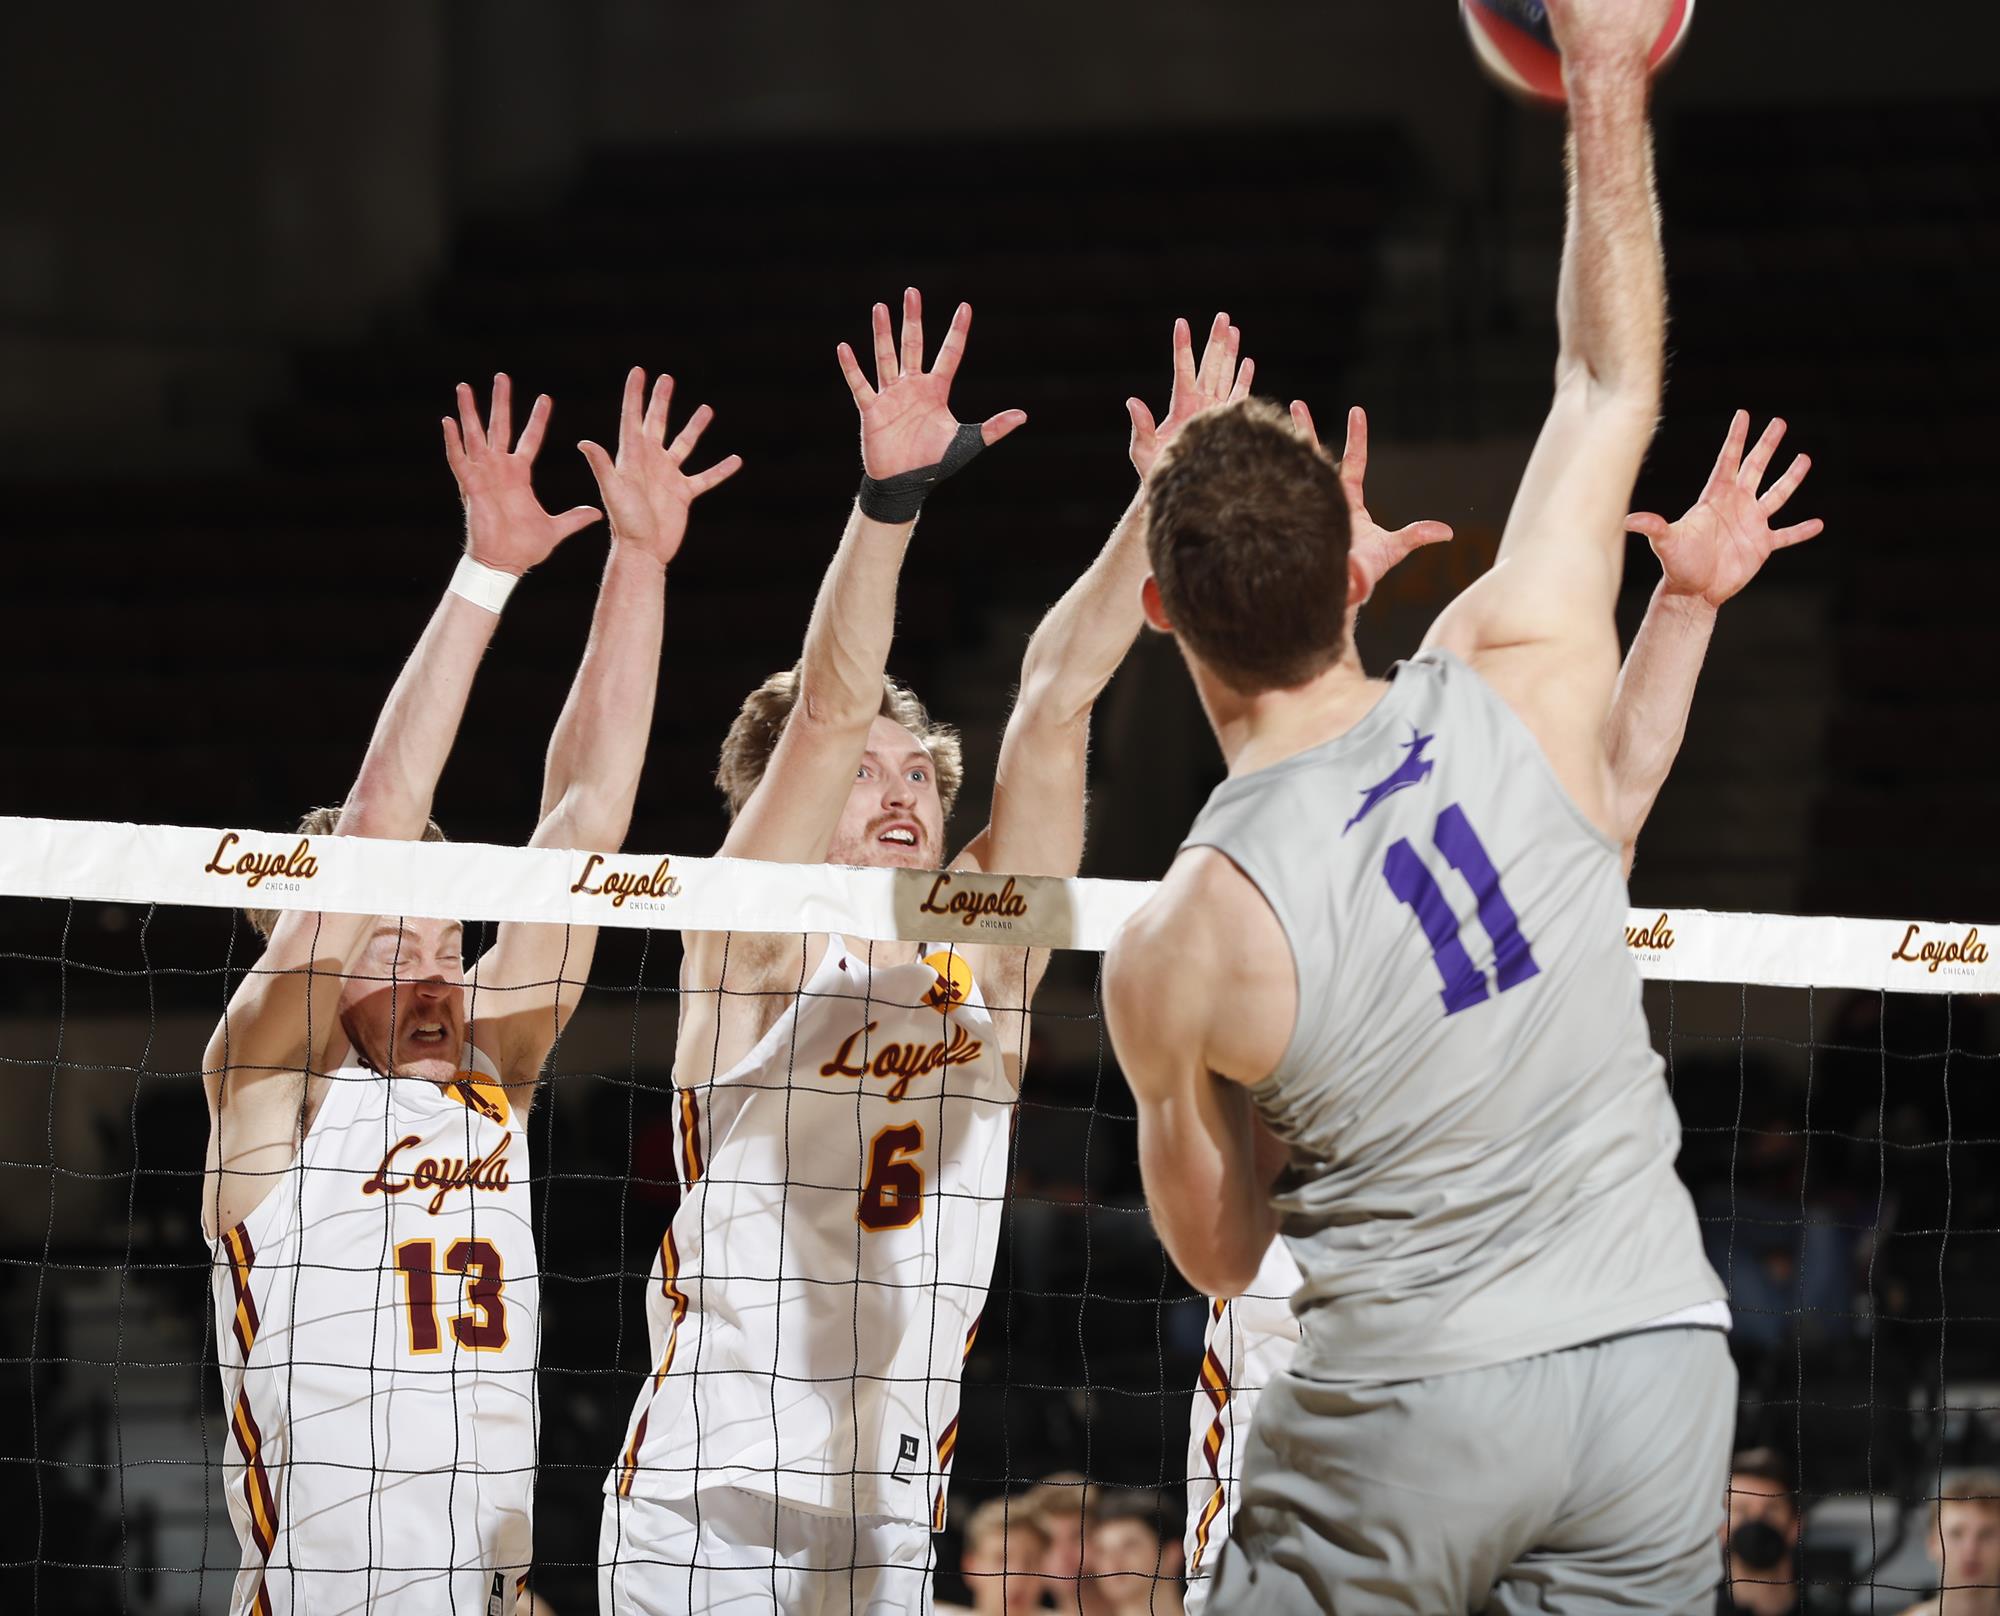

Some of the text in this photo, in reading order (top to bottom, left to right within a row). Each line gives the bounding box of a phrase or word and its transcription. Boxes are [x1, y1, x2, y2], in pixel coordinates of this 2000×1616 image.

[205, 832, 319, 888] Loyola
[570, 854, 682, 908] Loyola
[265, 882, 300, 892] CHICAGO
[629, 902, 666, 911] CHICAGO
[920, 873, 1027, 926] Loyola
[1382, 802, 1541, 1017] 11
[980, 919, 1013, 930] CHICAGO
[1891, 923, 1989, 973] Loyola
[1632, 953, 1661, 962] HICAGO
[1942, 967, 1976, 976] CHICAGO
[819, 1020, 982, 1104] Loyola
[362, 1131, 511, 1215] Loyola
[855, 1119, 925, 1233] 6
[394, 1237, 511, 1356] 13
[905, 1440, 915, 1456] XL
